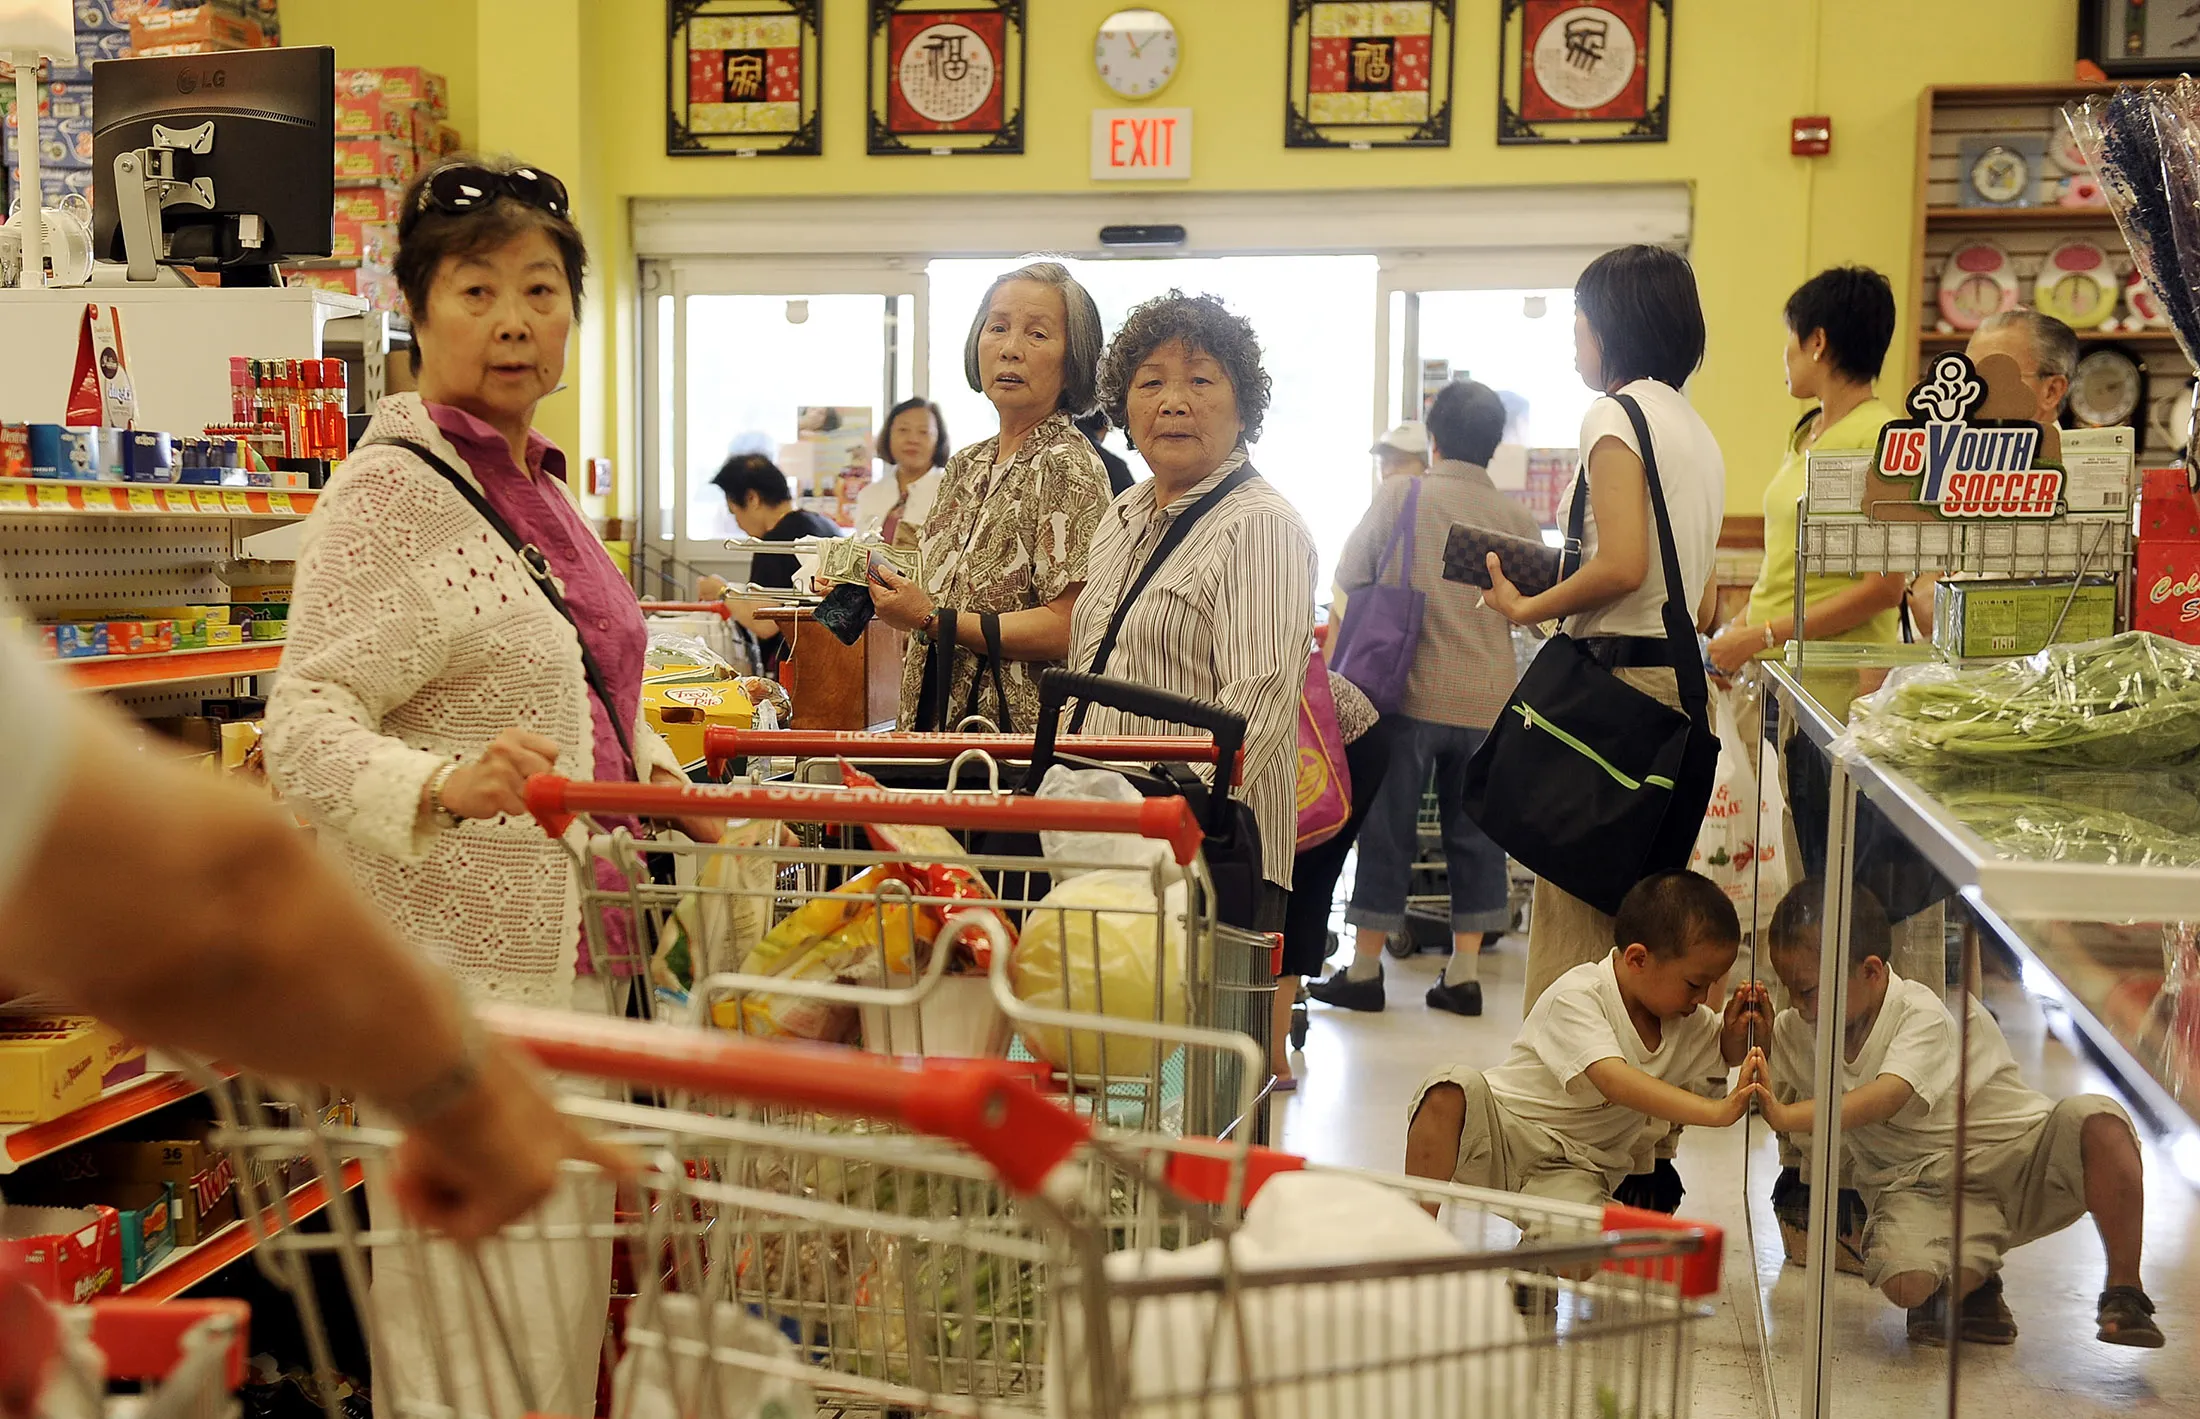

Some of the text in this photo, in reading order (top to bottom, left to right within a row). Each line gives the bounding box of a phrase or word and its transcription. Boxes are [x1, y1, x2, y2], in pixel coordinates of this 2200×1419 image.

[202, 68, 227, 88] LG
[1110, 119, 1178, 167] EXIT
[1883, 424, 2034, 501] US YOUTH
[1943, 473, 2059, 512] SOCCER
[162, 1147, 183, 1160] 36
